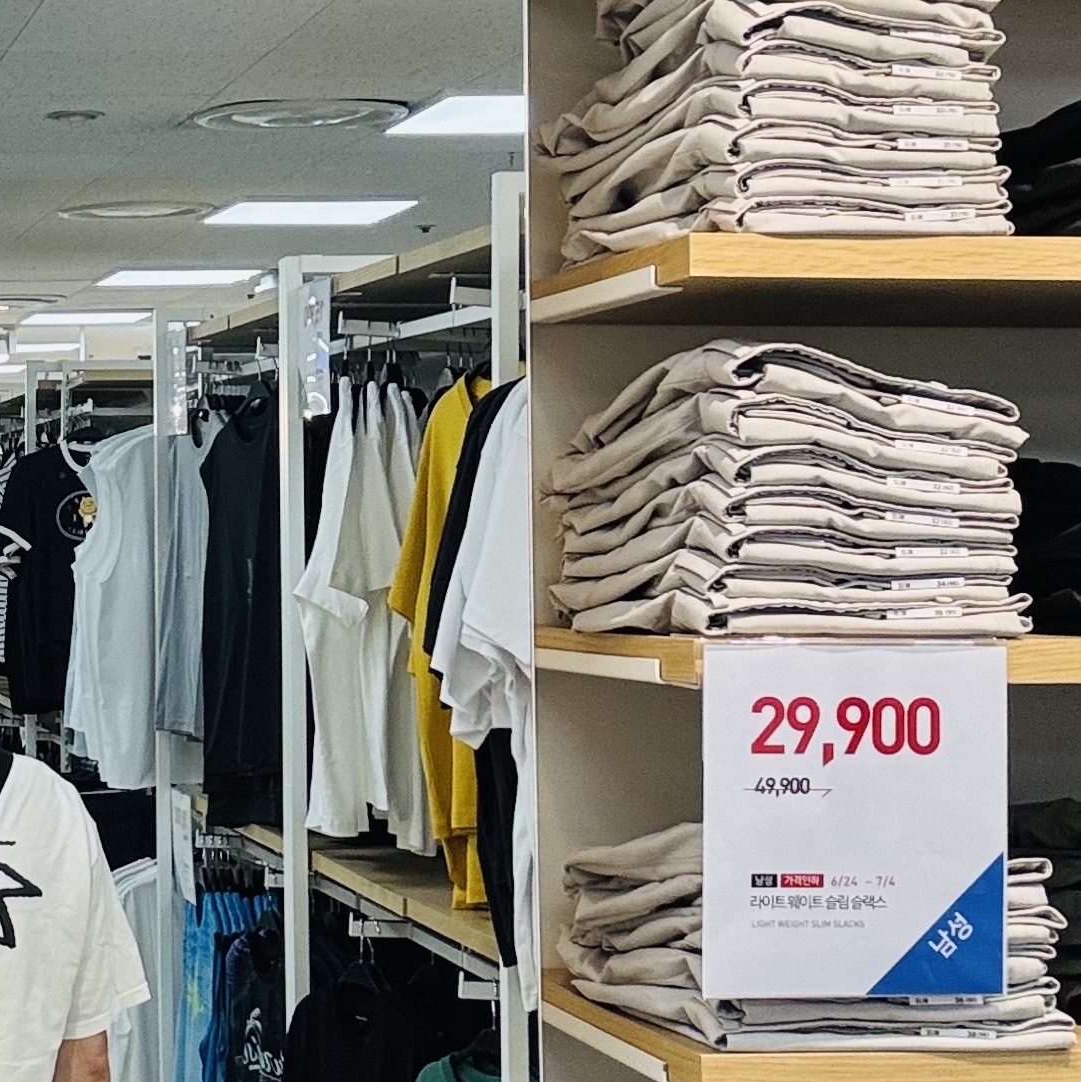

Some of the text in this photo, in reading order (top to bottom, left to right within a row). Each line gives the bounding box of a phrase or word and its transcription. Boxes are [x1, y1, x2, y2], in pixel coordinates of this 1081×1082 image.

[750, 696, 940, 767] 29,900
[754, 777, 811, 797] 49,900
[831, 875, 858, 887] 6/24
[876, 875, 896, 888] 7/4
[778, 920, 809, 929] WEIGHT
[811, 920, 831, 929] SLIM
[833, 920, 865, 929] SLACKS
[927, 911, 974, 959] 남성
